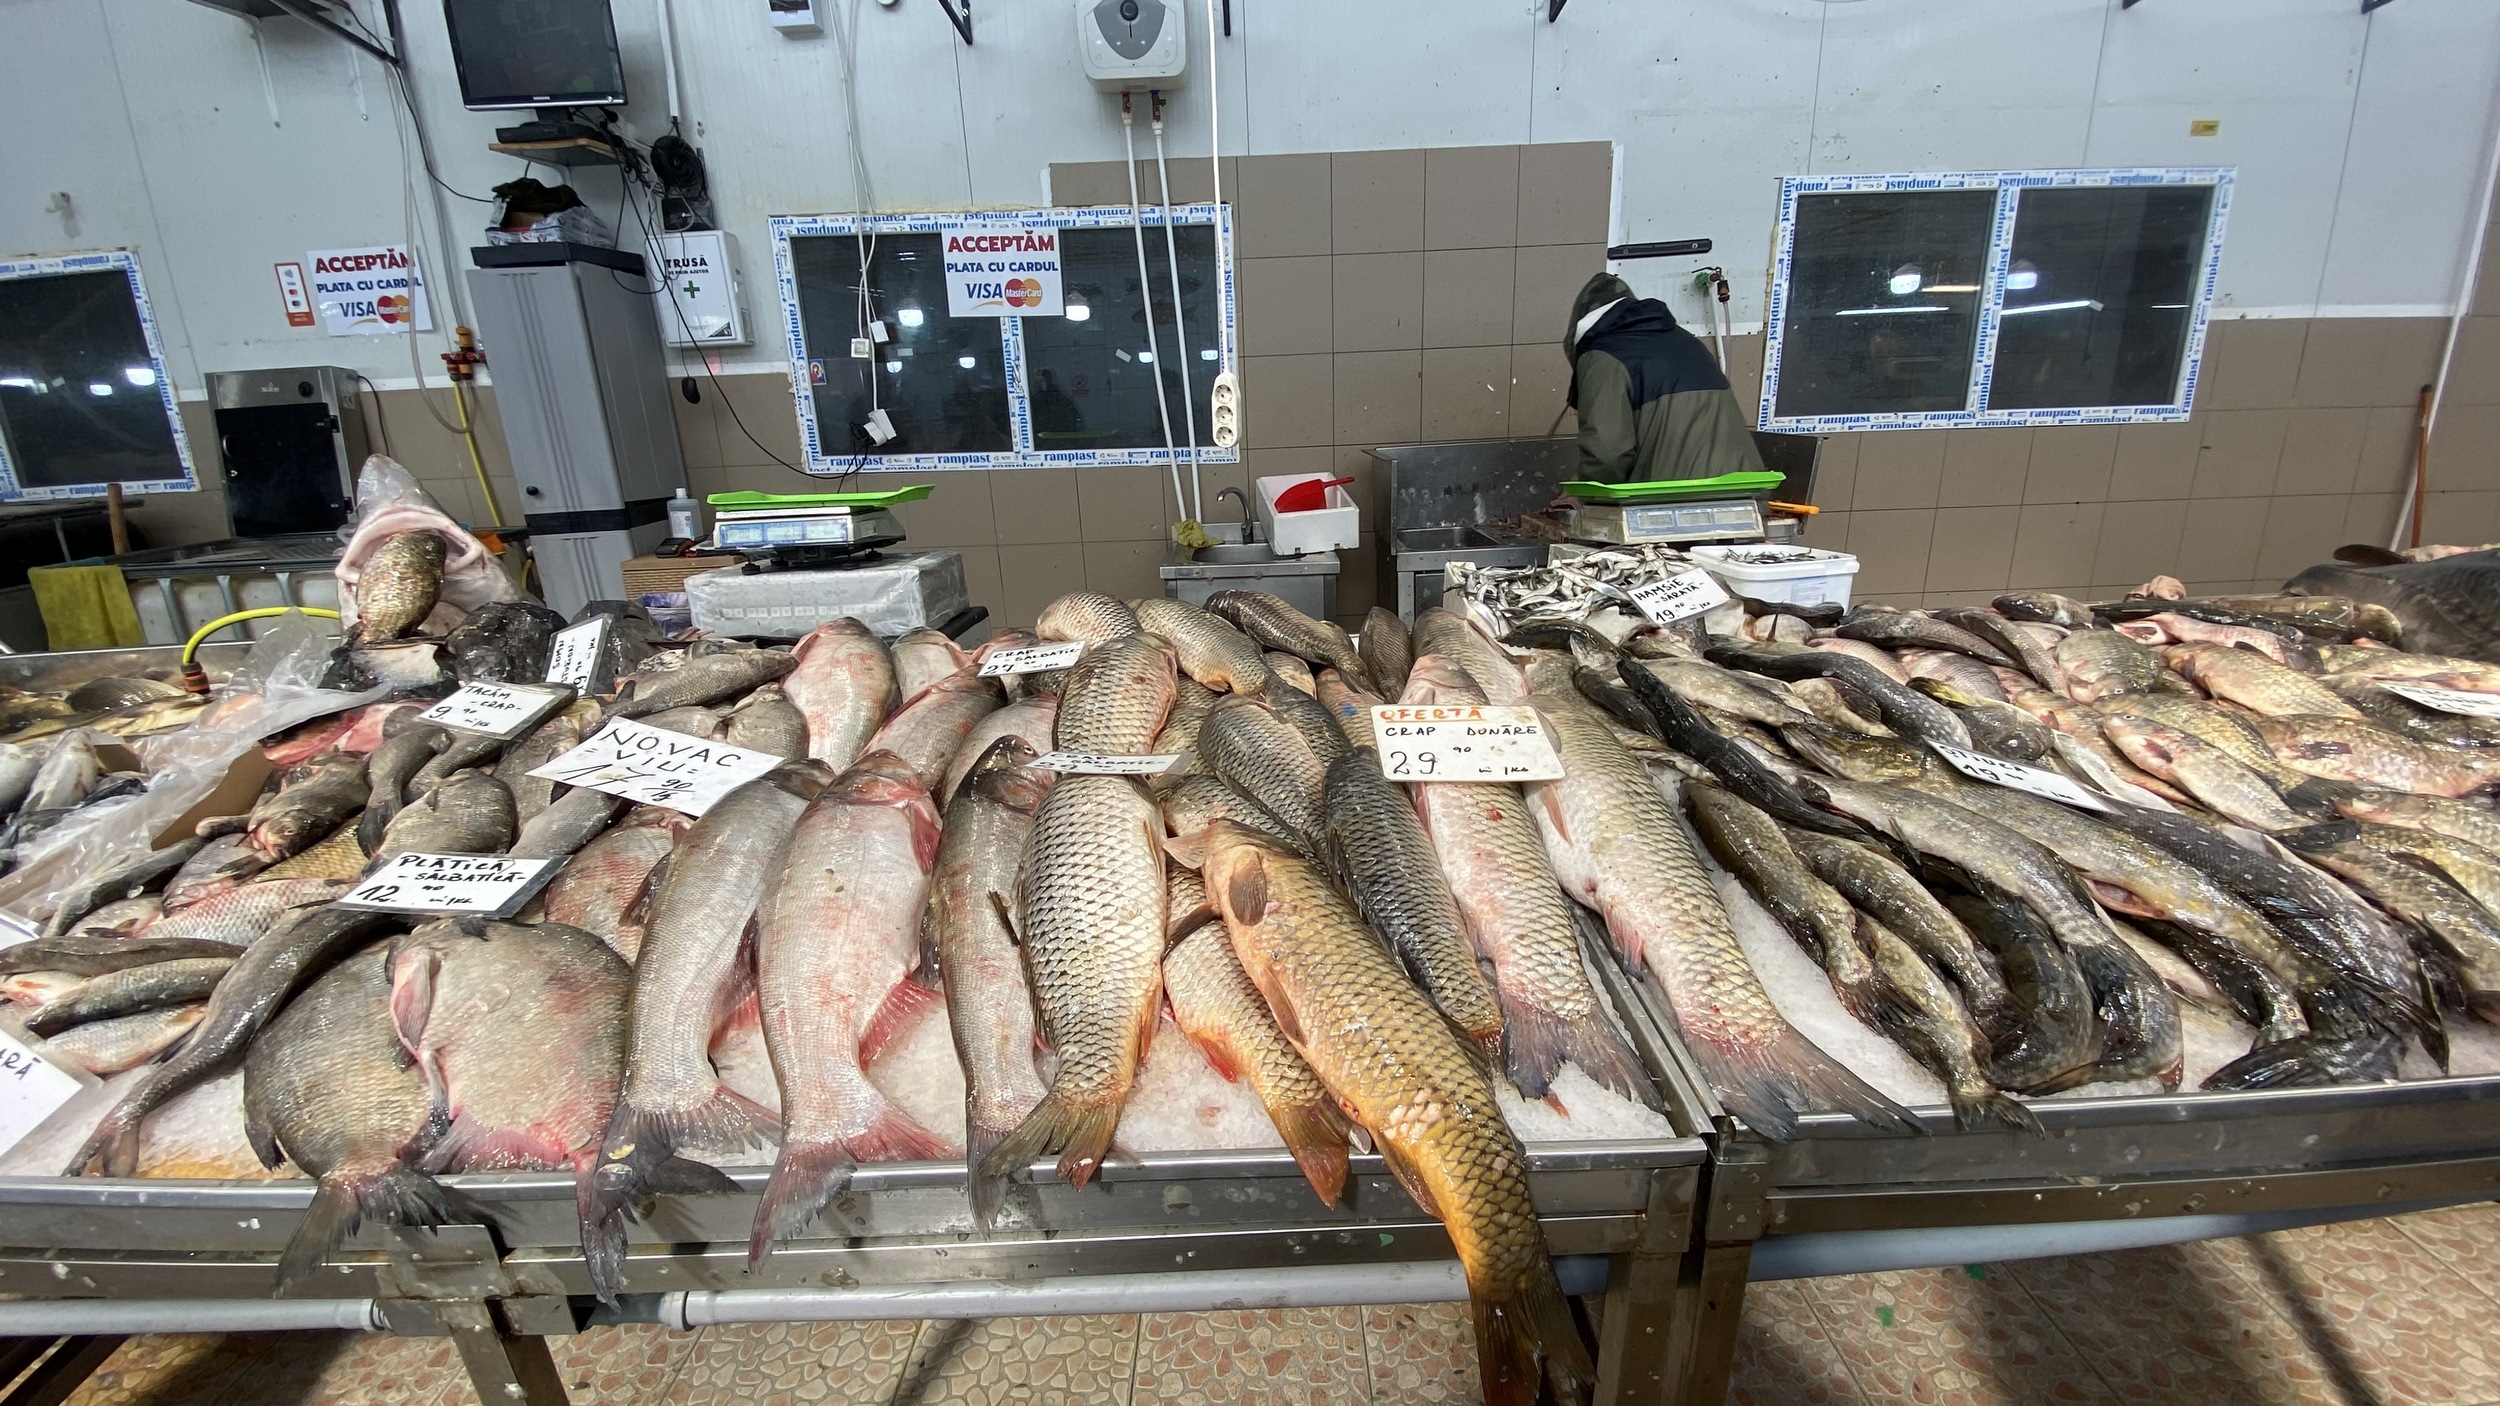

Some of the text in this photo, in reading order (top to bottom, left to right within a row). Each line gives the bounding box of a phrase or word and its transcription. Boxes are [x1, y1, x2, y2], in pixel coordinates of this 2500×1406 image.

[1885, 179, 1941, 191] ramplast
[947, 230, 1055, 252] ACCEPTĂM
[946, 261, 1059, 273] PLATA CU CARDUL
[316, 277, 422, 294] PLATA CU CARDL
[965, 283, 1042, 299] VISA MasterCard
[339, 300, 377, 318] VISA
[789, 303, 806, 362] ramplast
[937, 453, 991, 465] ramplast
[1044, 451, 1097, 462] ramplast
[1380, 706, 1485, 720] OFERTĂ
[1385, 727, 1436, 736] CRAP
[598, 728, 742, 768] NOVAC
